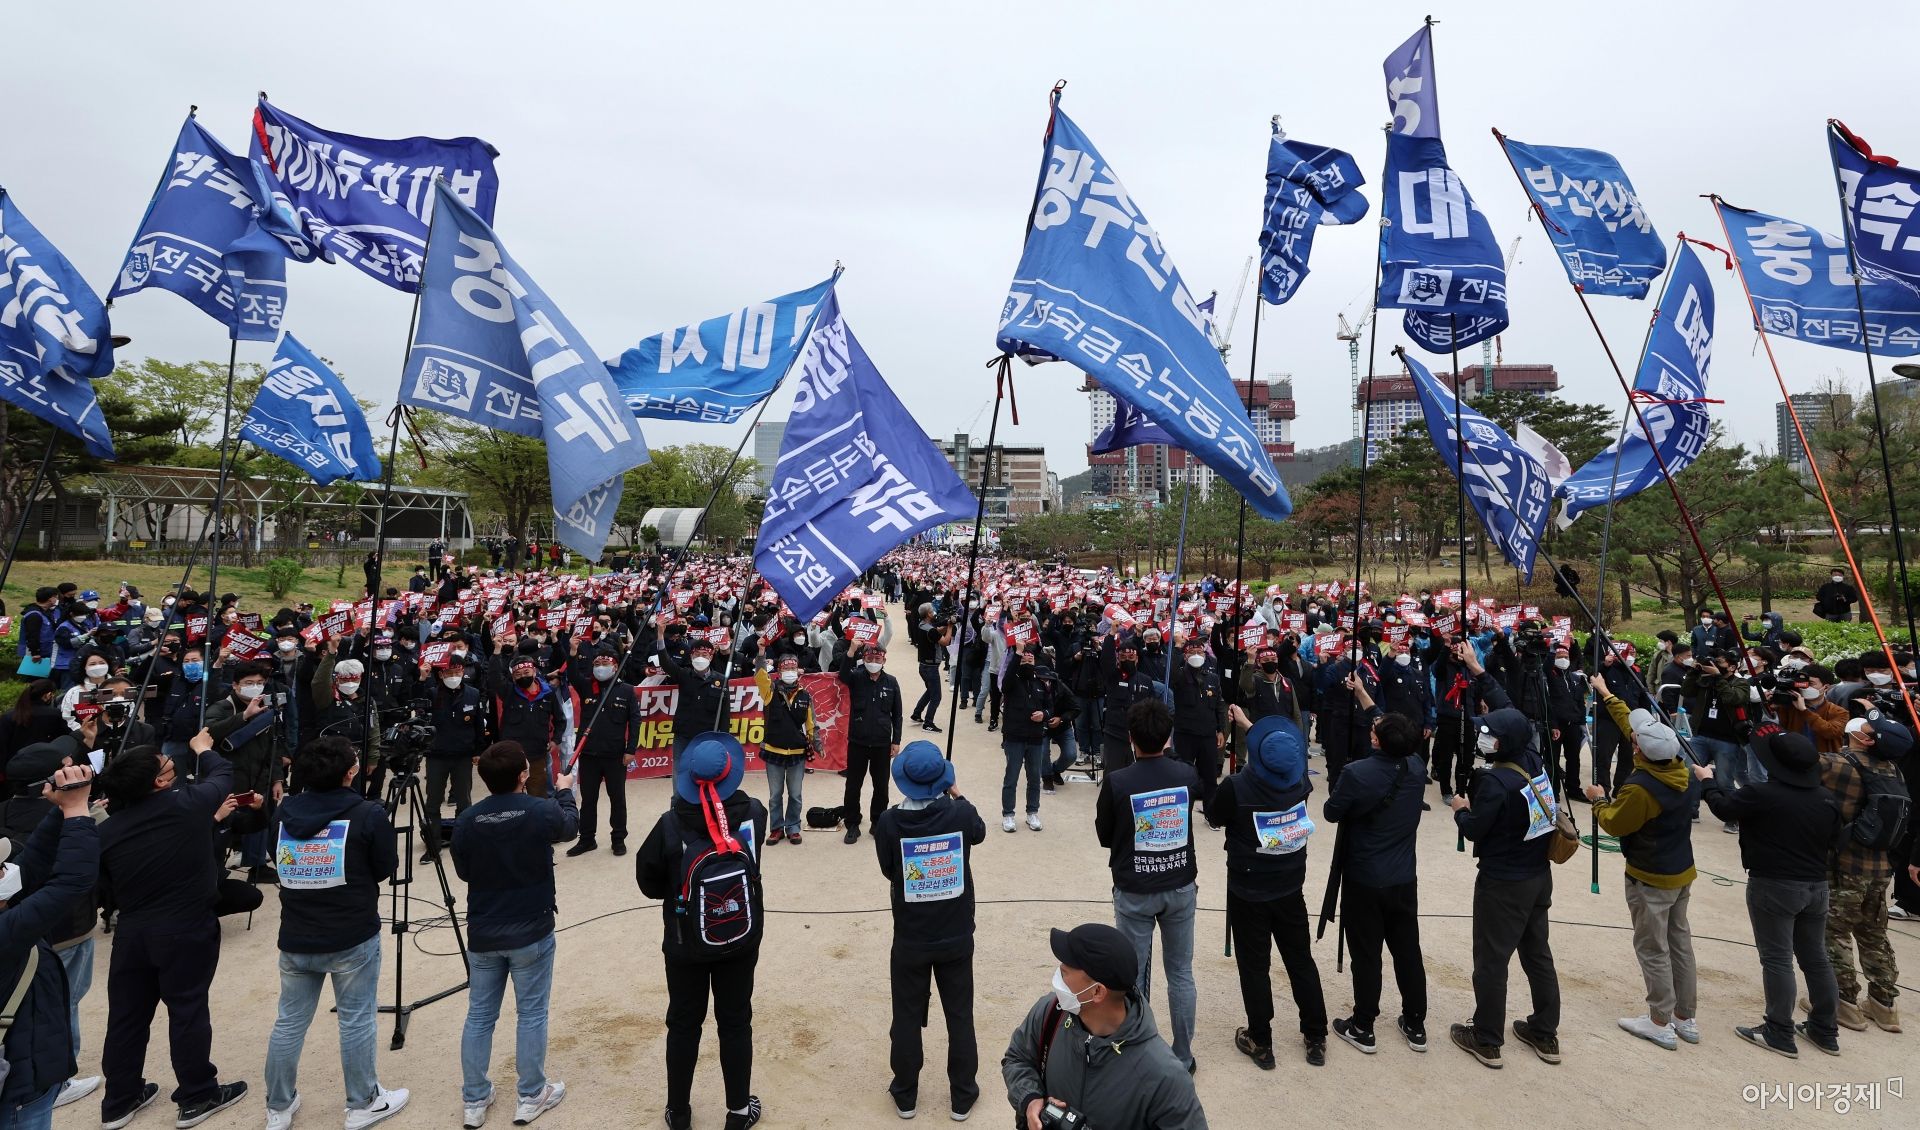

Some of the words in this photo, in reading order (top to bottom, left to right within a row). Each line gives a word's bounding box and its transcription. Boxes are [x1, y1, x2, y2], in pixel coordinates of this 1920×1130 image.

[1399, 167, 1486, 240] 대
[642, 756, 669, 768] 2022
[1134, 851, 1187, 864] 전국금속노동조합
[1135, 858, 1187, 873] 현대자동차지부
